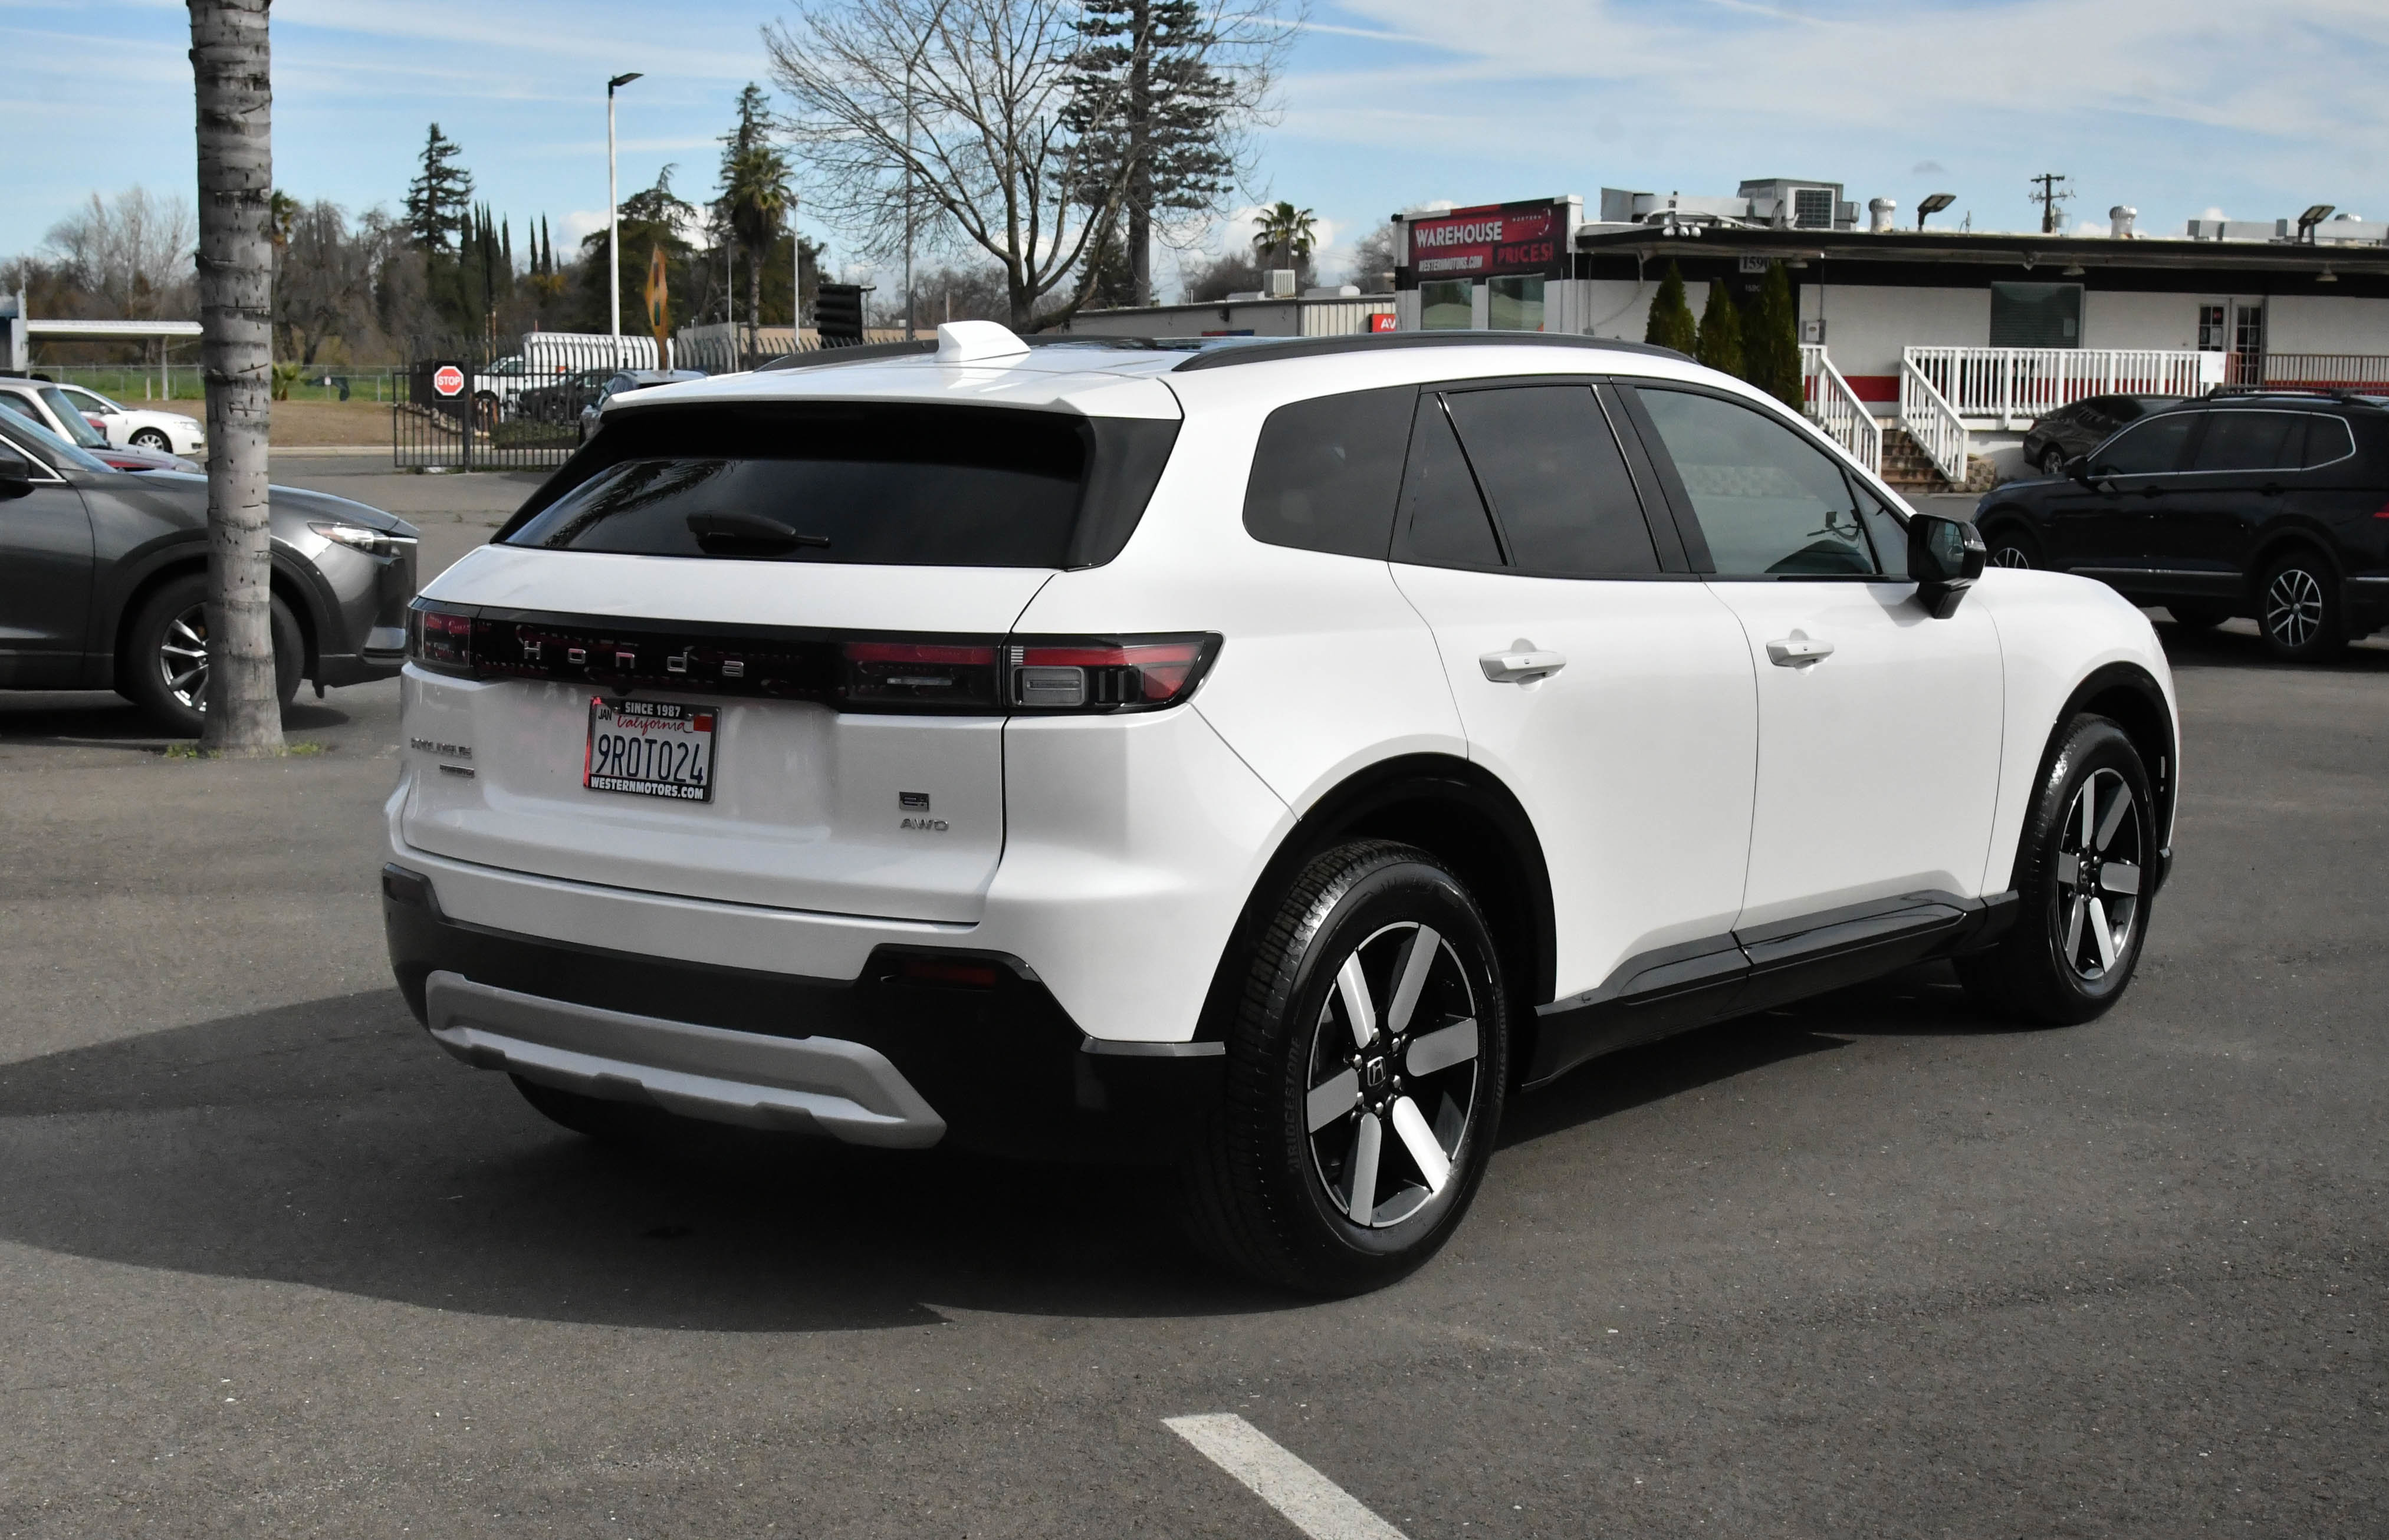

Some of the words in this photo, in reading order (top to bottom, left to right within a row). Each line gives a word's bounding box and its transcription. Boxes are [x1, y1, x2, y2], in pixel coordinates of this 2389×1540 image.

[1415, 221, 1503, 248] WAREHOUSE
[1381, 318, 1396, 329] AV
[438, 376, 461, 386] STOP
[598, 709, 612, 721] JAN
[625, 701, 653, 716] SINCE
[657, 703, 681, 718] 1987
[617, 715, 694, 736] California
[590, 776, 704, 800] WESTERNMOTORS.COM
[900, 818, 949, 831] AWD
